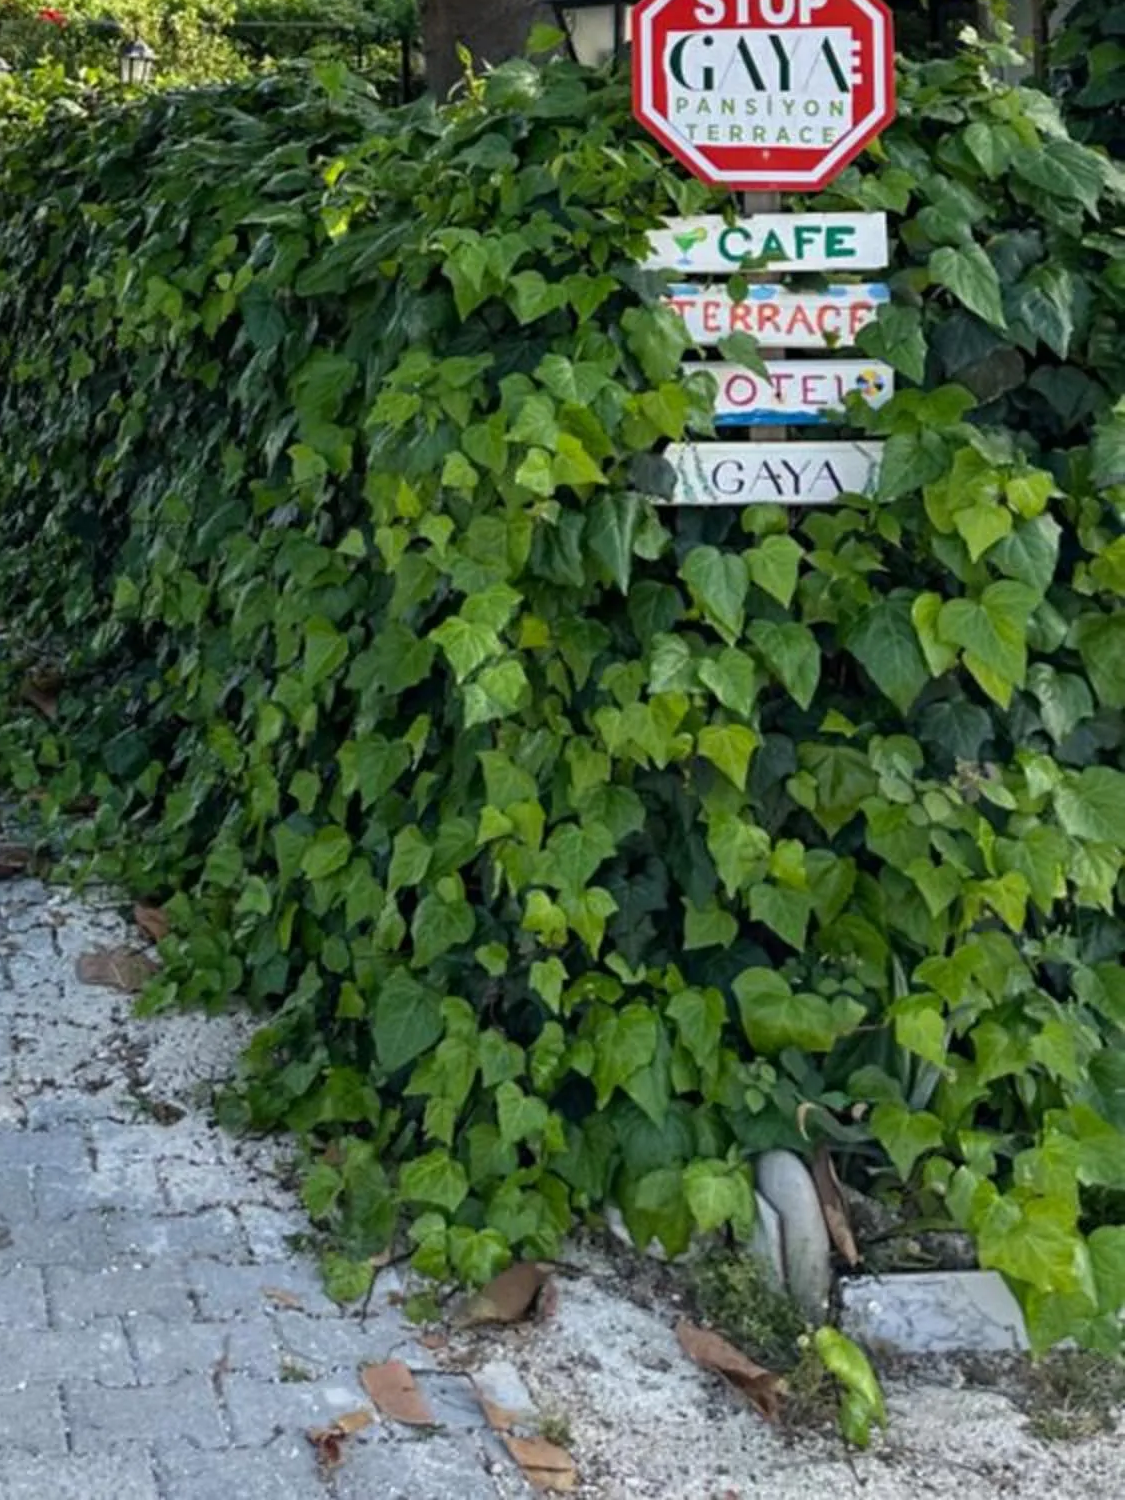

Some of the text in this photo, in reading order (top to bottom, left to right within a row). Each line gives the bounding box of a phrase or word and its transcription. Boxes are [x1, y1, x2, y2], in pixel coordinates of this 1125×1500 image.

[669, 33, 850, 93] GAYA
[685, 123, 837, 144] TERRACE
[717, 225, 857, 262] CAFE
[711, 459, 845, 496] GAYA
